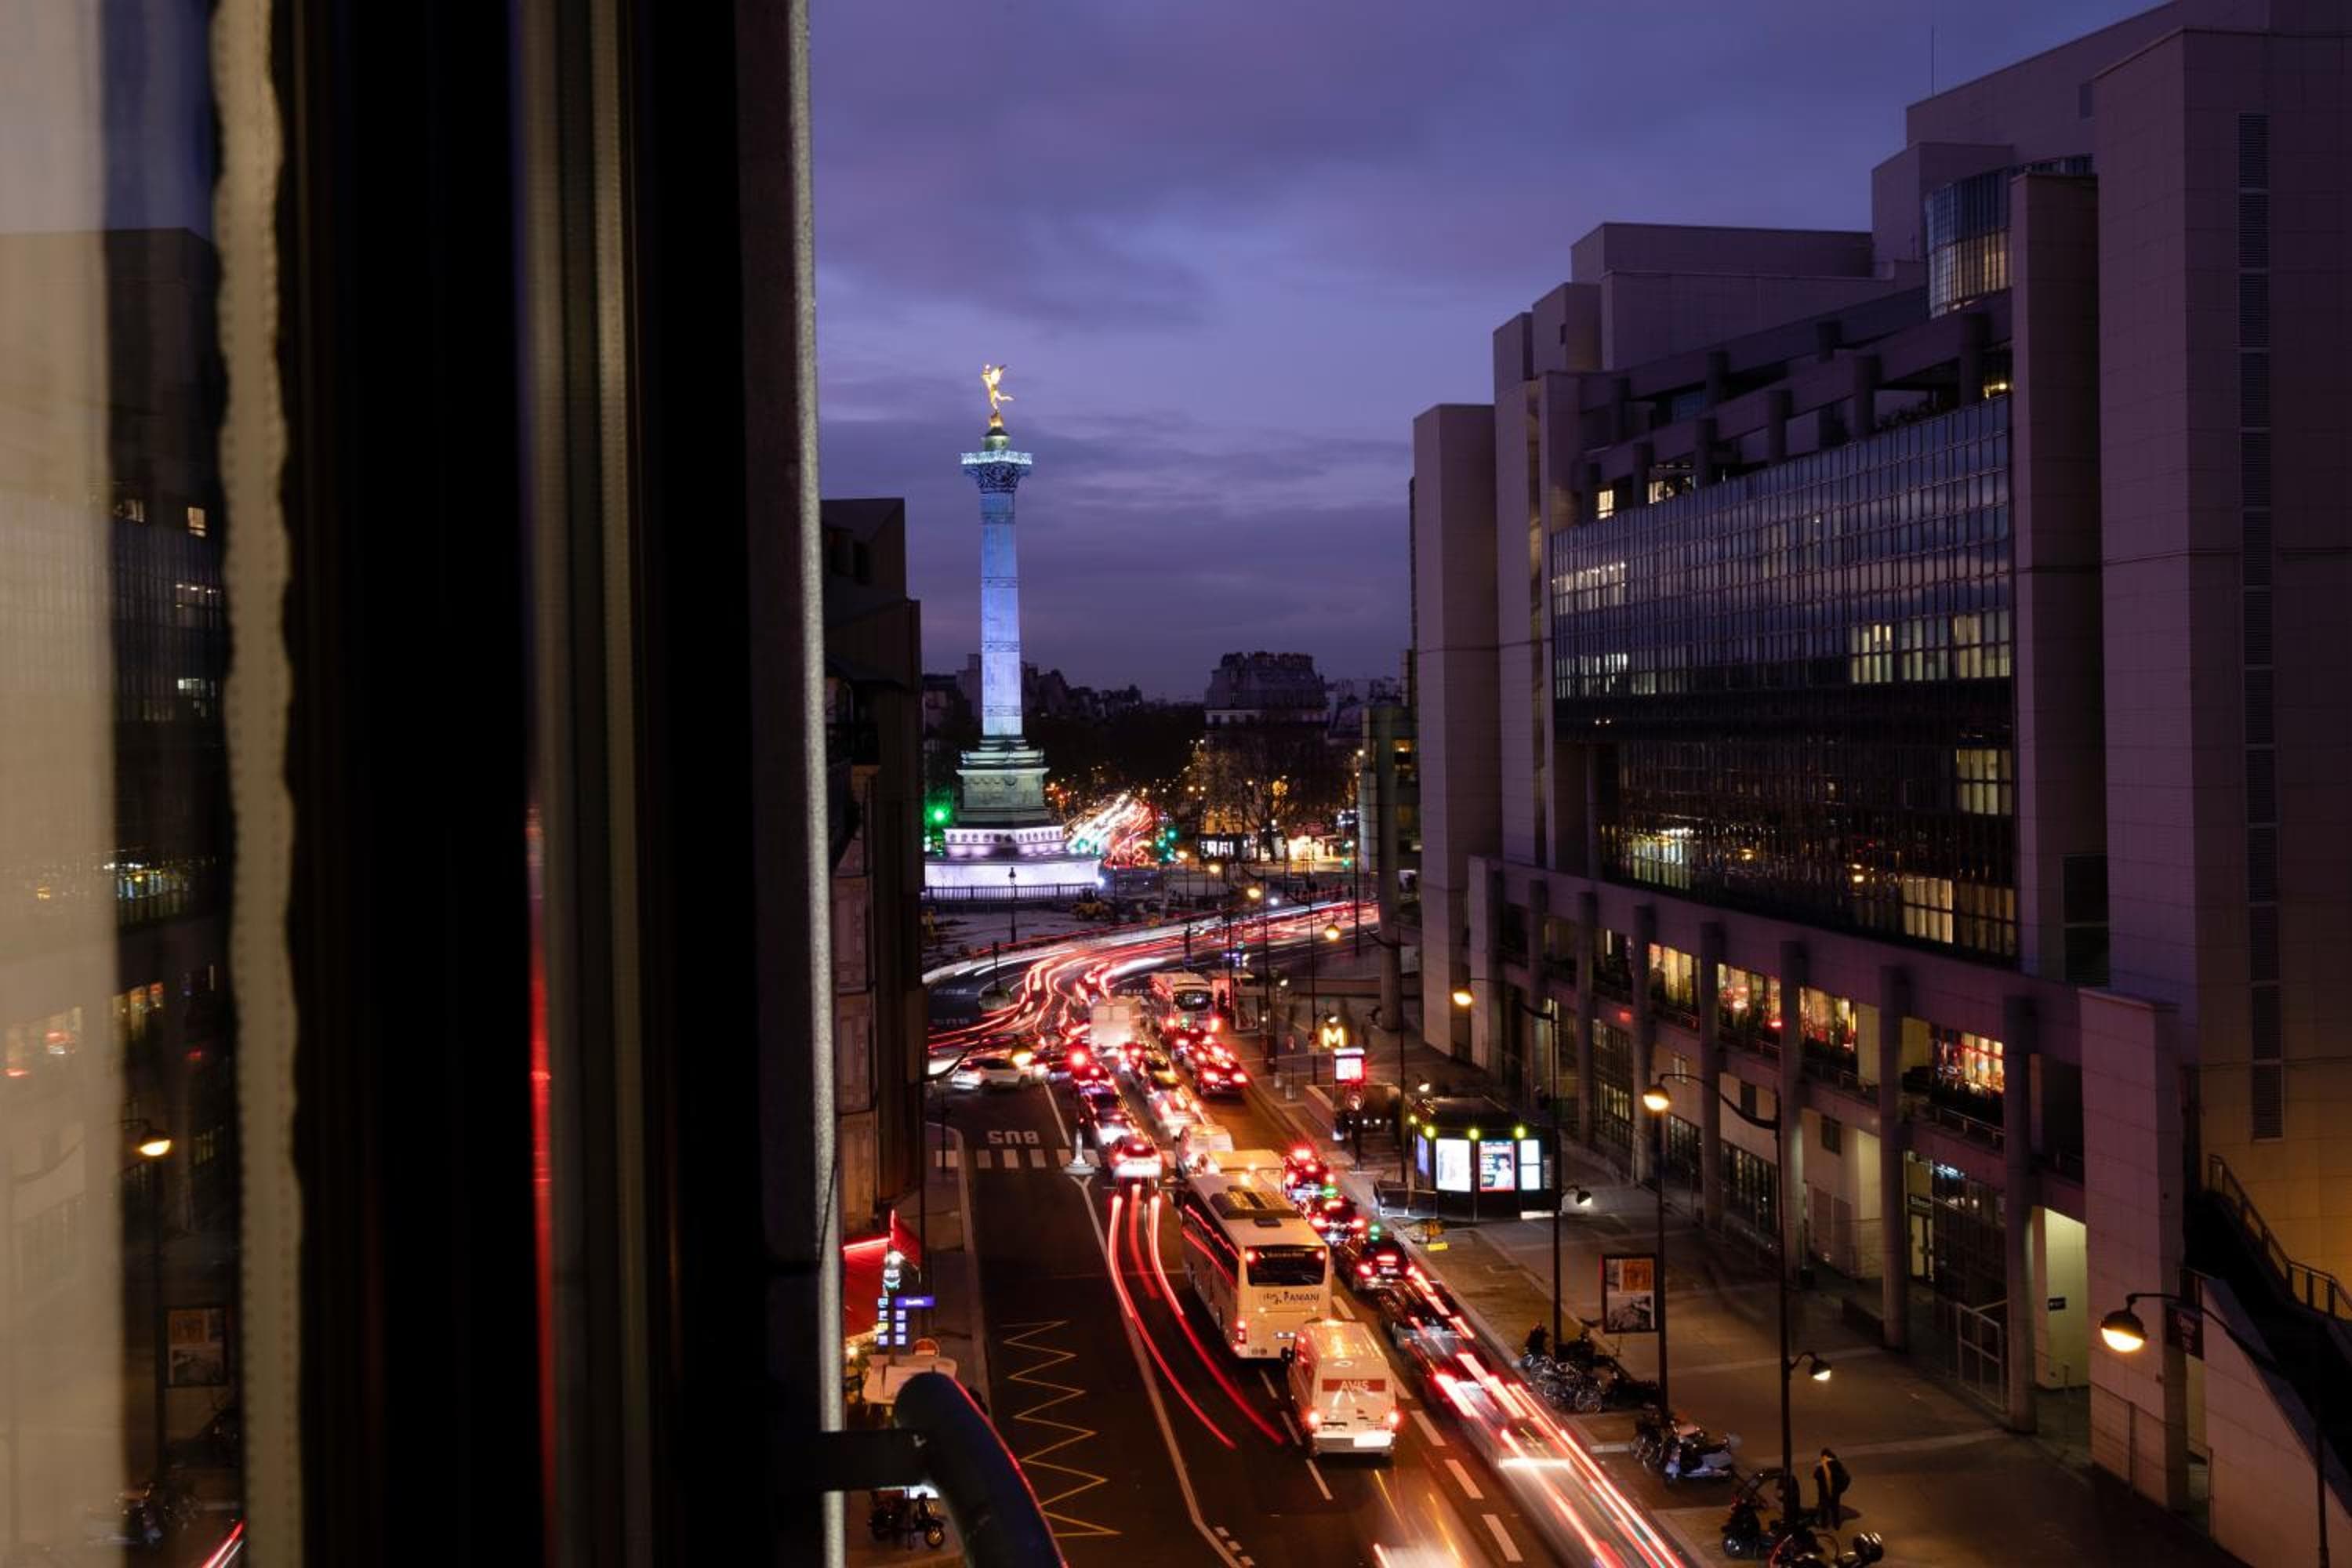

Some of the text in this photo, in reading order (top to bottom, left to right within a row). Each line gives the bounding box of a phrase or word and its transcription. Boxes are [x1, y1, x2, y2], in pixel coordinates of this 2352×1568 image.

[1323, 1027, 1345, 1047] M
[988, 1131, 1040, 1144] BUS
[1341, 1380, 1369, 1391] AVIS
